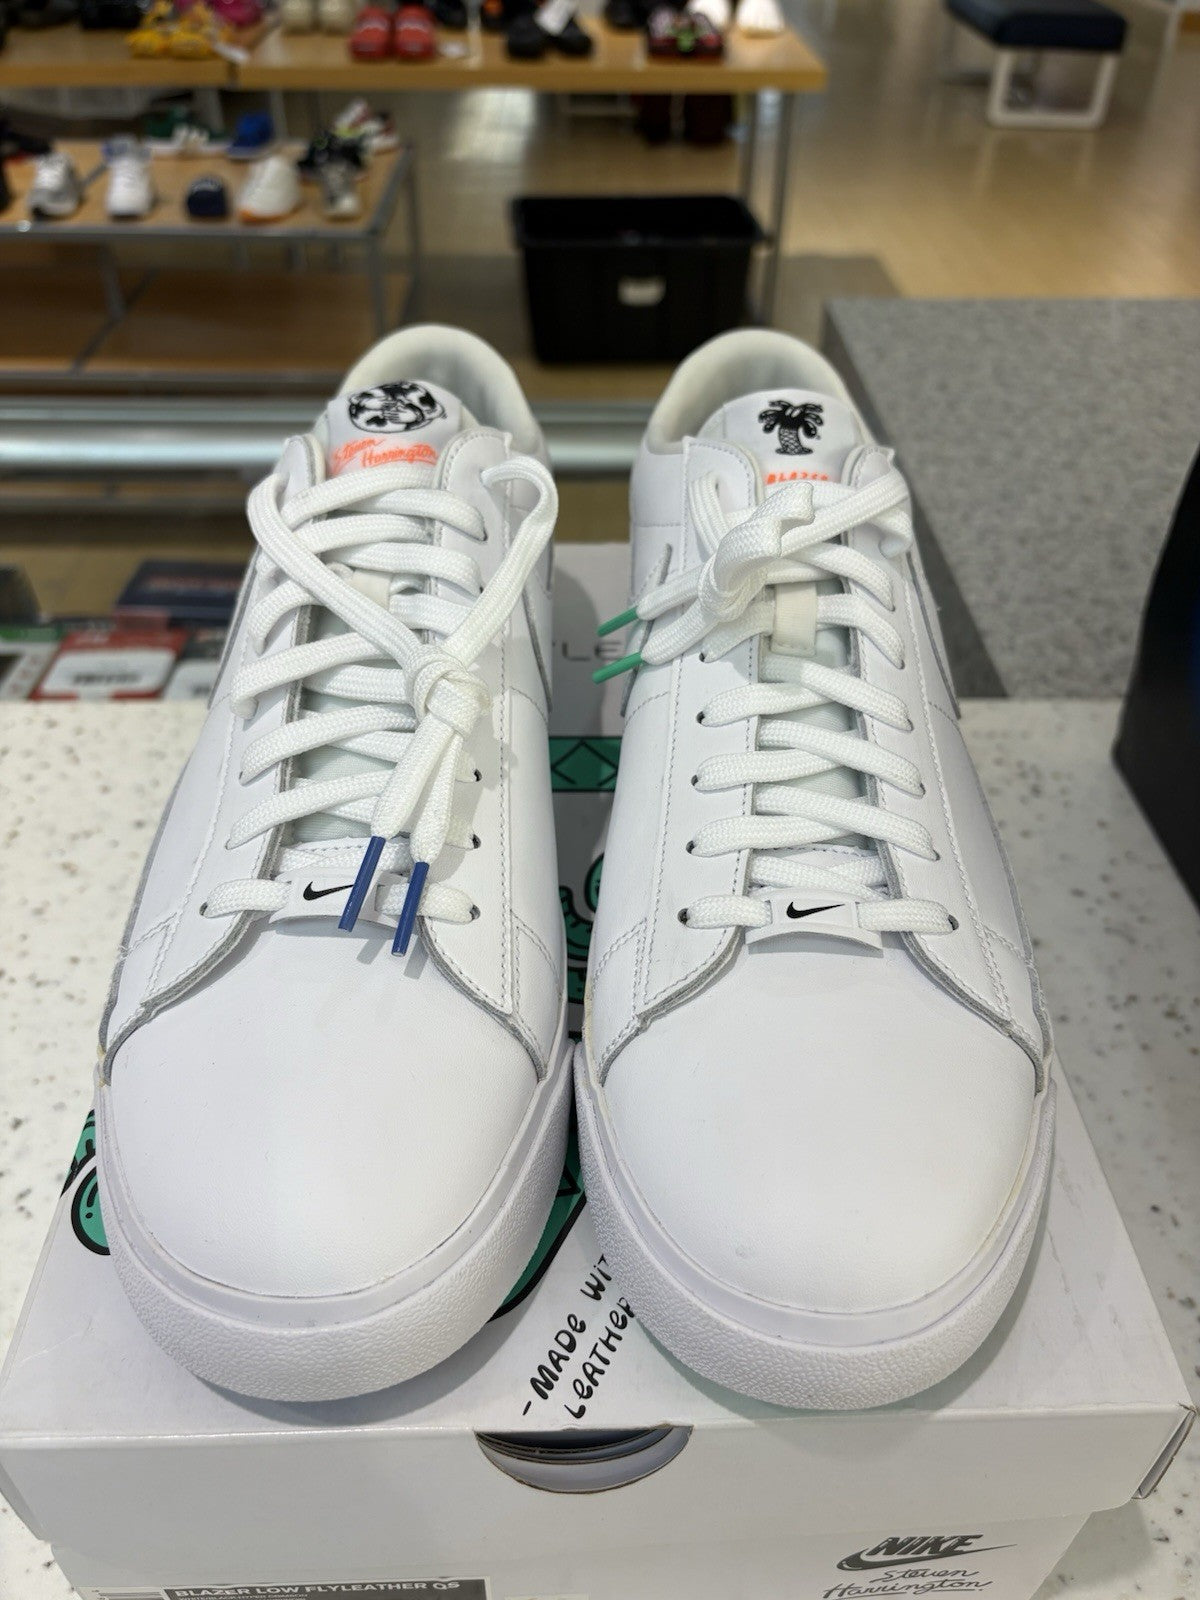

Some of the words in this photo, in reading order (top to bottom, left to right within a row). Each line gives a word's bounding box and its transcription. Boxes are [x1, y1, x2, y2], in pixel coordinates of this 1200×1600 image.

[866, 1534, 984, 1556] NIKE
[869, 1568, 981, 1584] Steven
[174, 1588, 251, 1597] BLAZER
[255, 1586, 299, 1594] LOW
[305, 1582, 428, 1593] FLYLEATHER
[432, 1581, 461, 1590] QS
[822, 1578, 993, 1599] Harrington
